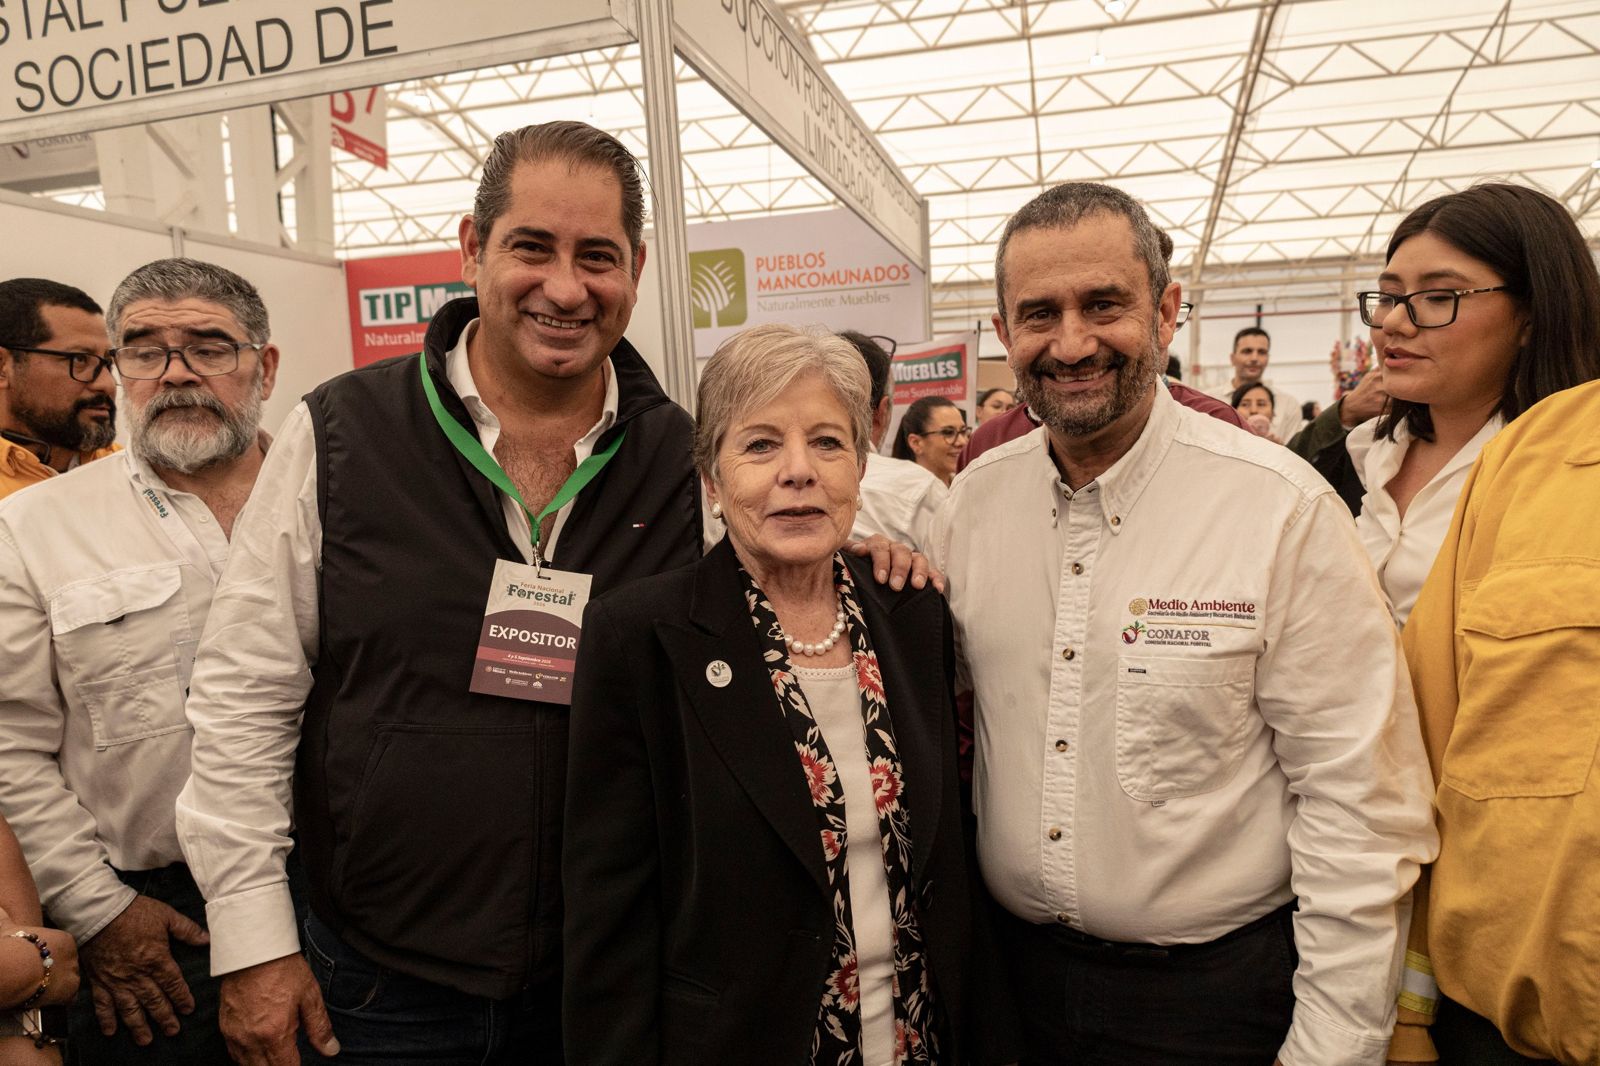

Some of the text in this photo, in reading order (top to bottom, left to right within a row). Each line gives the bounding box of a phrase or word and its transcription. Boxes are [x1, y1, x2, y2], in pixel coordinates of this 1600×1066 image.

[14, 17, 294, 113] SOCIEDAD
[314, 0, 398, 64] DE
[756, 251, 826, 273] PUEBLOS
[757, 263, 910, 292] MANCOMUNADOS
[757, 290, 891, 313] Naturalmente Muebles
[507, 583, 574, 606] Forestal
[520, 582, 565, 594] Feria Nacional
[1148, 598, 1256, 614] Medio Ambiente
[488, 624, 577, 650] EXPOSITOR
[1146, 629, 1210, 641] CONAFOR
